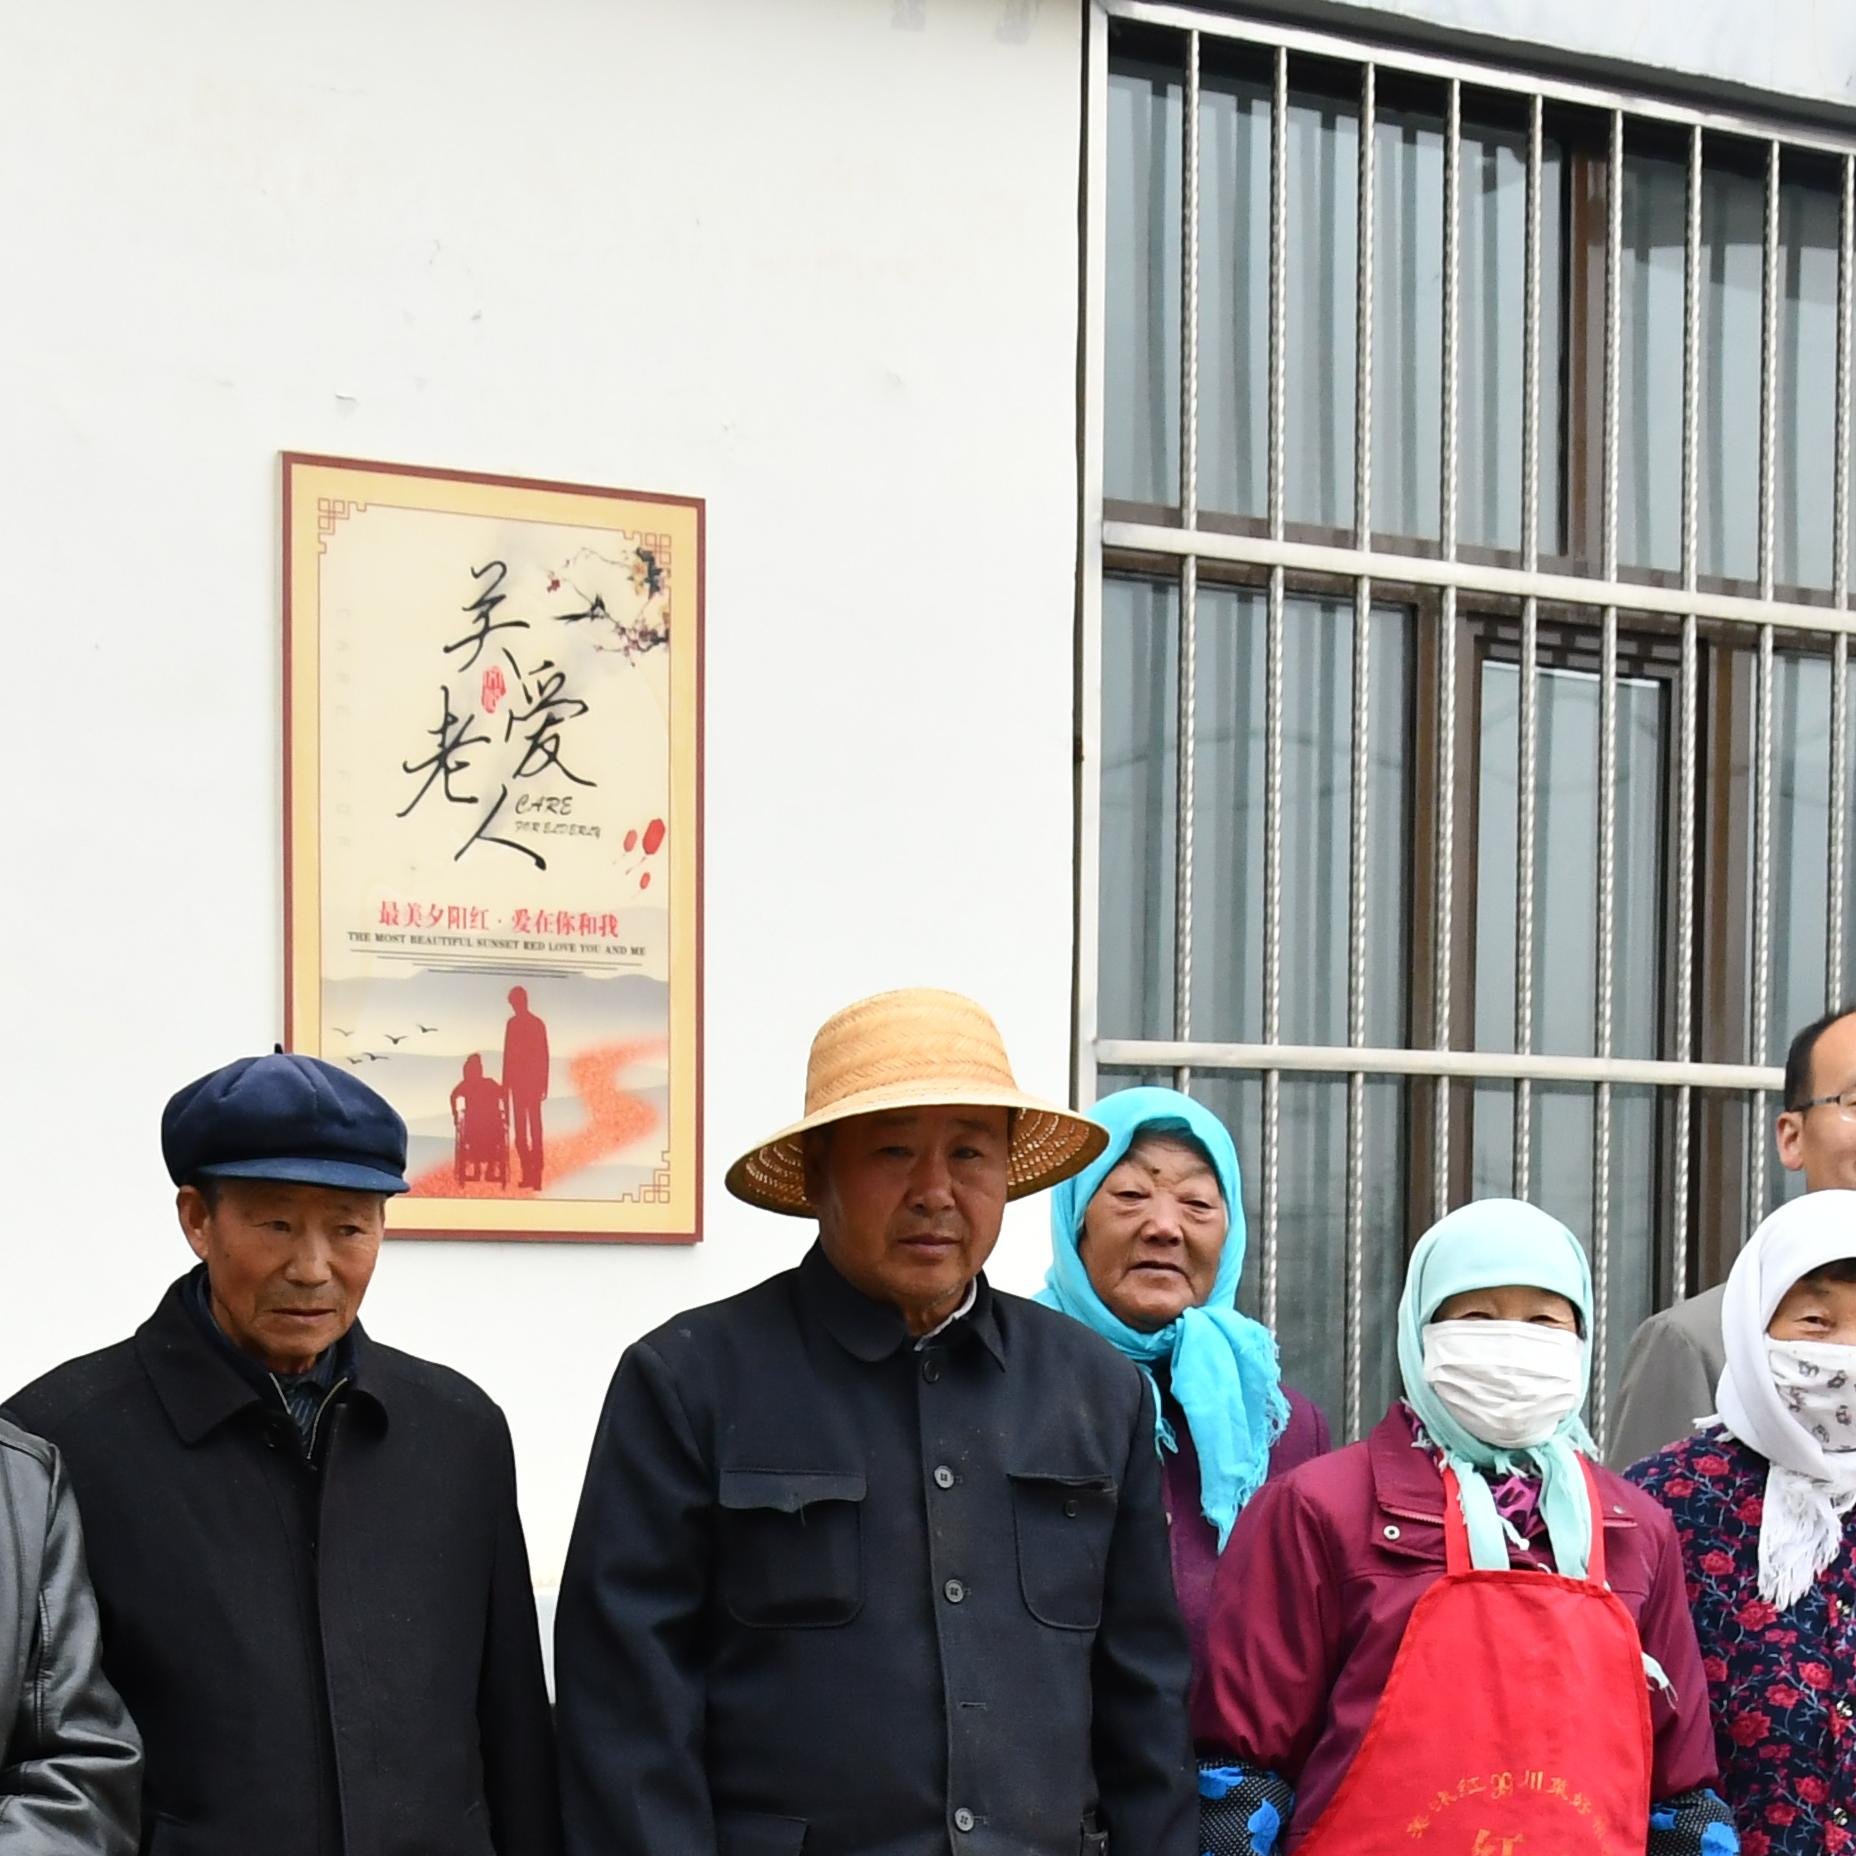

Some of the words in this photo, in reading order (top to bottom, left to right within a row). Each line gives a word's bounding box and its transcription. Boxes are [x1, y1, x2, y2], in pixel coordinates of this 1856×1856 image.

[515, 793, 573, 816] CARE
[347, 931, 371, 942] THE
[374, 933, 407, 944] MOST
[410, 934, 473, 947] BEAUTIFUL
[477, 937, 519, 949] SUNSET
[523, 940, 545, 951] RED
[548, 941, 577, 953] LOVE
[579, 943, 600, 954] YOU
[605, 945, 628, 956] AND
[630, 946, 646, 956] ME
